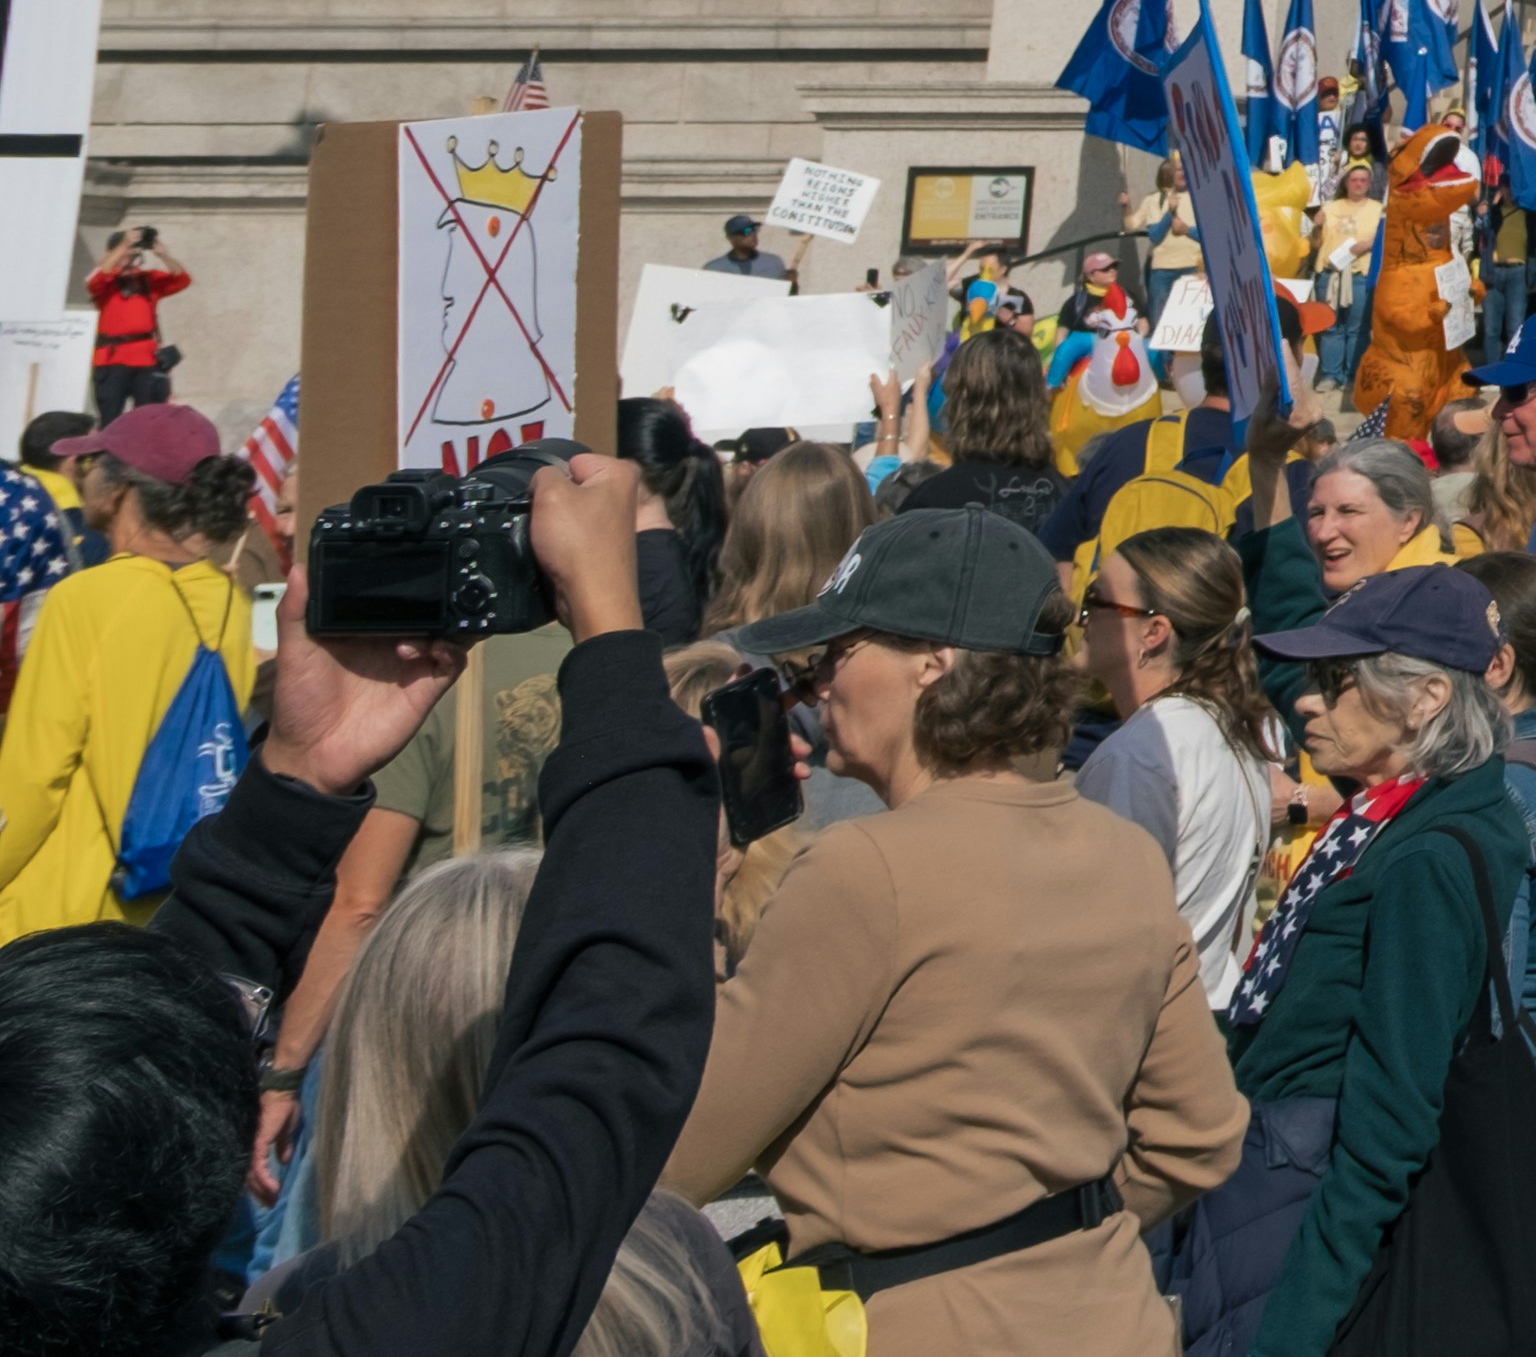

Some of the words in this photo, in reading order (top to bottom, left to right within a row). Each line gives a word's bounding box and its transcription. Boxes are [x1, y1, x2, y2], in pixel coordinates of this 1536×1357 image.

[804, 166, 864, 187] NOTHING
[806, 178, 857, 197] REIGNS
[791, 197, 825, 214] THAN
[826, 203, 849, 219] THE
[802, 190, 849, 207] HIGHER
[772, 206, 858, 235] CONSTITUTION
